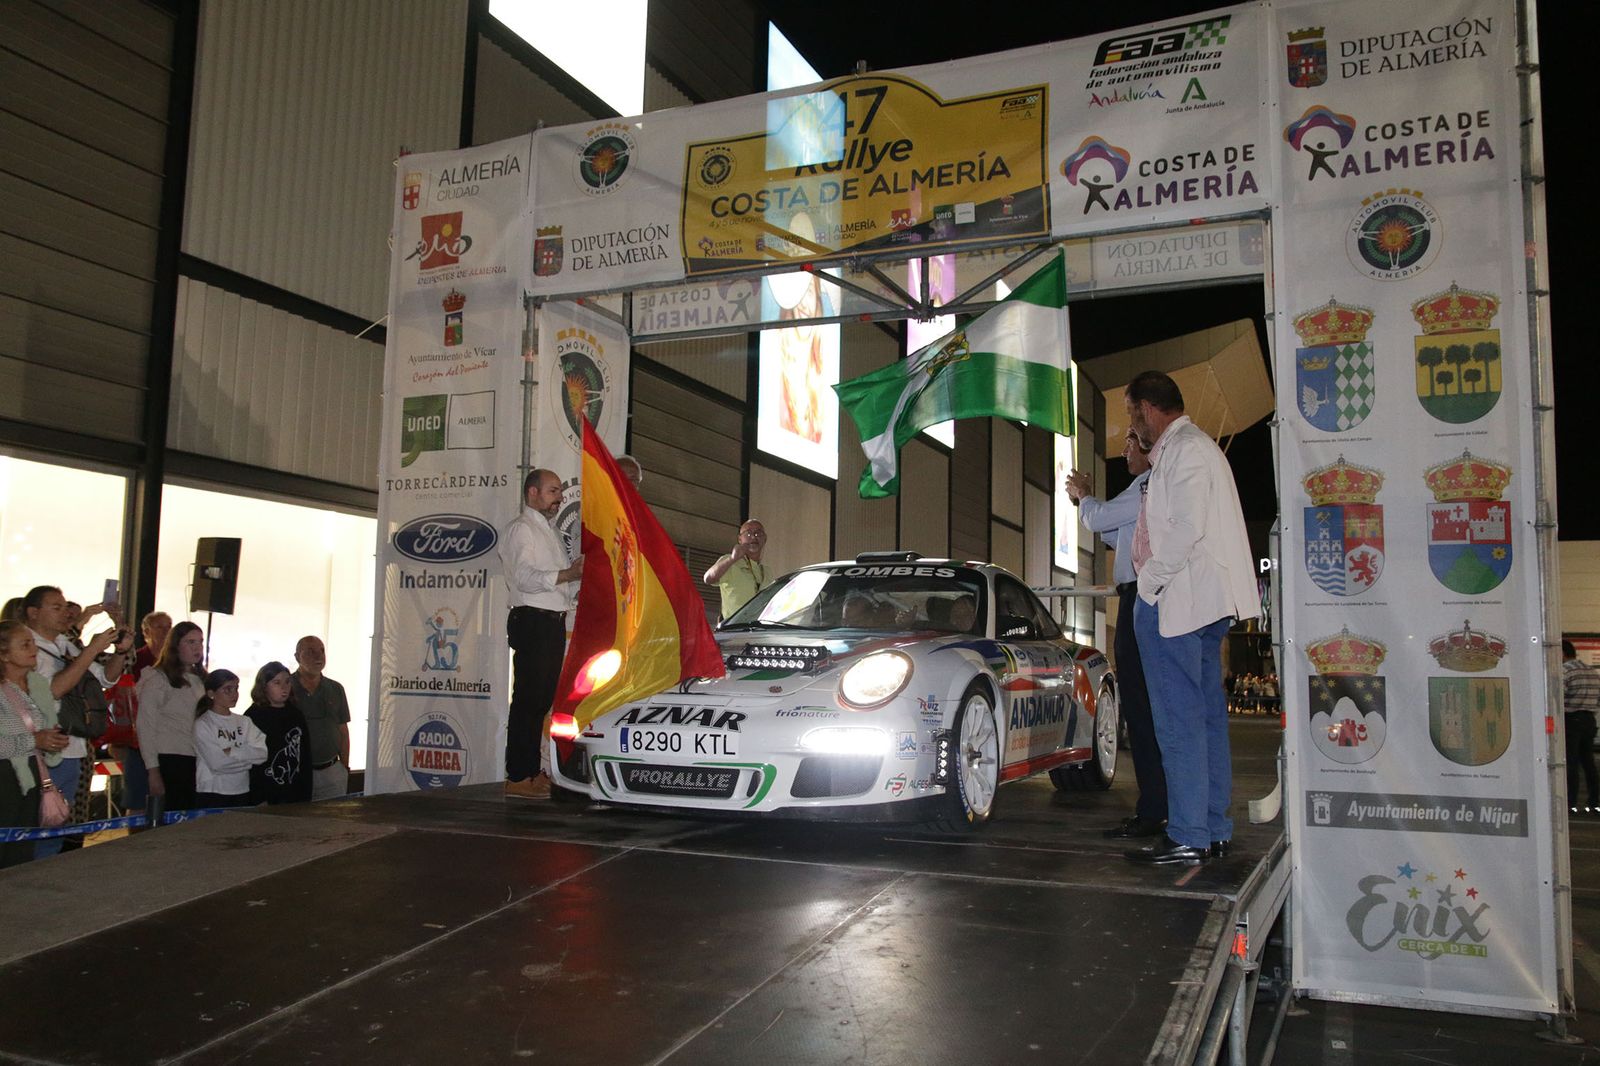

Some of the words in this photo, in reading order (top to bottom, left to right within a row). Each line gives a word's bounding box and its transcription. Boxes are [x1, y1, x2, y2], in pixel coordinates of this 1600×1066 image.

[1340, 17, 1493, 57] DIPUTACIÓN
[1162, 50, 1223, 66] andaluza
[1341, 59, 1372, 79] DE
[1378, 38, 1488, 73] ALMERÍA
[1085, 79, 1103, 90] de
[1107, 61, 1222, 85] automovilismo
[1088, 83, 1165, 108] Andalucía
[1165, 106, 1184, 114] Junta
[1184, 104, 1193, 112] de
[1194, 99, 1226, 111] Andalucía
[1365, 114, 1451, 142] COSTA
[1458, 110, 1490, 130] DE
[1138, 151, 1217, 177] COSTA
[1224, 144, 1255, 164] DE
[1340, 131, 1496, 178] ALMERÍA
[438, 155, 521, 188] ALMERÍA
[710, 185, 811, 218] COSTA
[819, 178, 859, 204] DE
[868, 150, 1012, 198] ALMERÍA
[436, 184, 480, 202] CIUDAD
[1114, 165, 1259, 211] ALMERÍA
[833, 219, 877, 234] ALMERÍA
[1351, 196, 1409, 233] AUTOMOVIL
[1414, 201, 1437, 224] CLUB
[570, 223, 671, 254] DIPUTACIÓN
[572, 254, 595, 272] DE
[597, 243, 669, 269] ALMERÍA
[1369, 264, 1422, 279] ALMERIA
[408, 351, 463, 366] Ayuntamiento
[464, 349, 473, 359] de
[473, 346, 497, 357] Vícar
[413, 522, 476, 553] Ford
[399, 569, 488, 589] Indamóvil
[390, 676, 428, 690] Diario
[428, 677, 443, 691] de
[443, 678, 491, 693] Almería
[613, 706, 748, 732] AZNAR
[1009, 693, 1065, 731] ANDAMUR
[418, 731, 455, 746] RADIO
[622, 744, 627, 752] E
[632, 731, 682, 752] 8290
[694, 733, 736, 756] KTL
[411, 749, 461, 771] MARCA
[629, 769, 732, 788] PRORALLYE
[1347, 800, 1450, 823] Ayuntamiento
[1455, 804, 1474, 822] de
[1479, 804, 1519, 829] Níjar
[1346, 875, 1491, 961] Enix
[1399, 940, 1446, 953] CERCA
[1452, 944, 1468, 954] DE
[1474, 945, 1488, 956] TI
